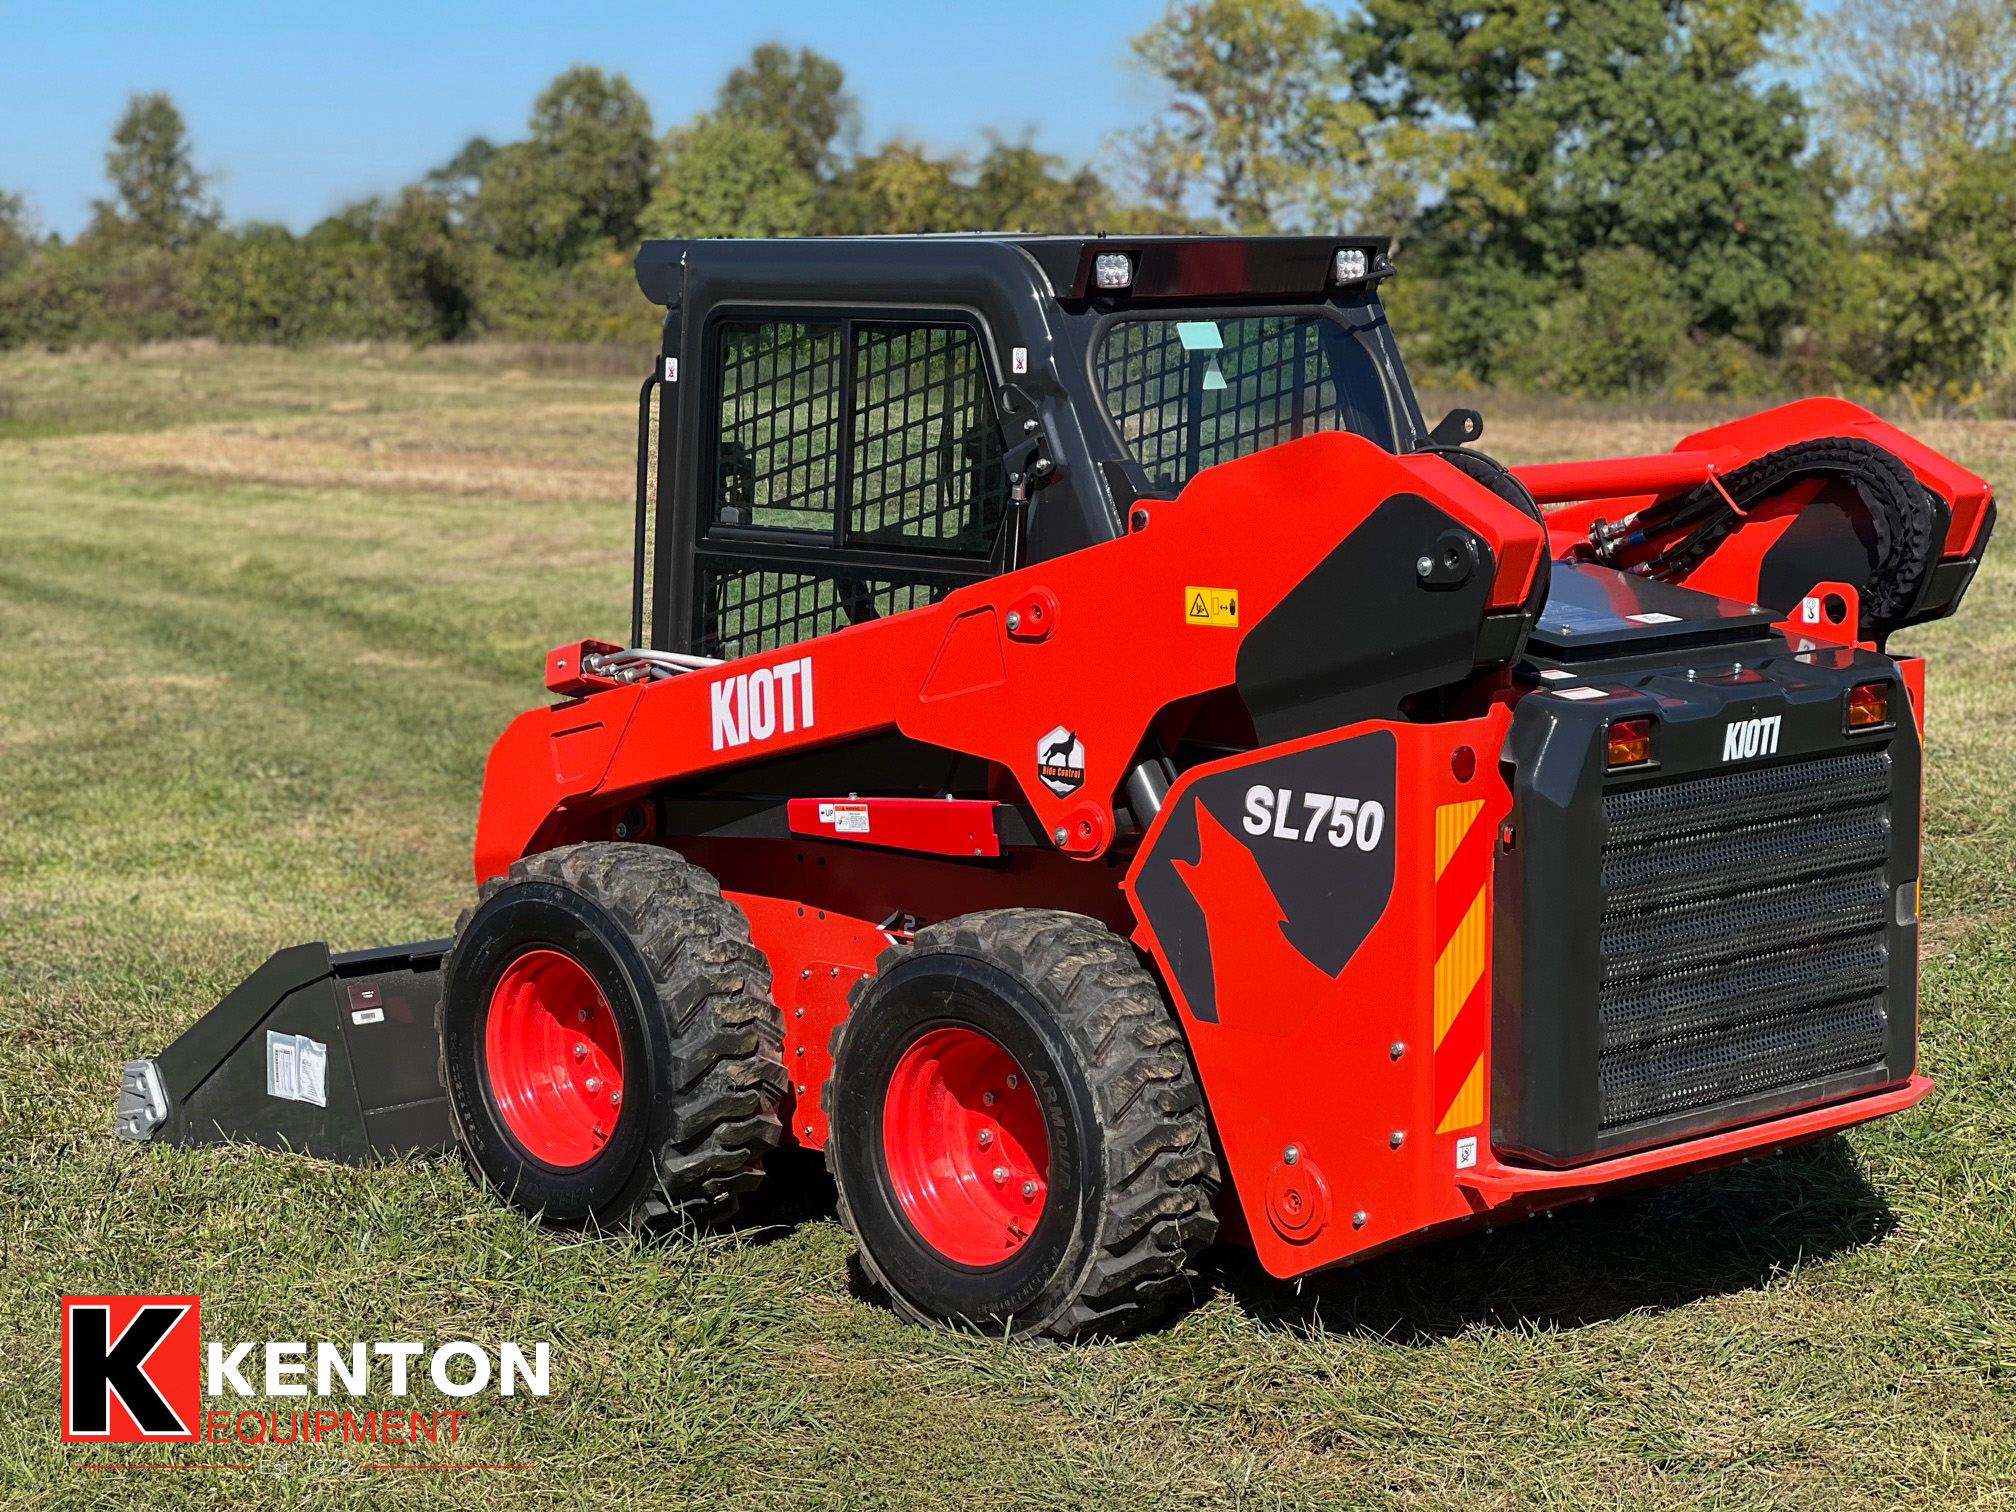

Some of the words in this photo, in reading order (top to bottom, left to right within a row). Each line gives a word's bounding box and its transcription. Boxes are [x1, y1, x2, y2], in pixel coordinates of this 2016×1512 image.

[710, 656, 814, 751] KIOTI
[1722, 715, 1782, 762] KIOTI
[1042, 765, 1057, 776] Ride
[1057, 767, 1081, 779] Control
[825, 809, 834, 818] UP
[1242, 784, 1386, 852] SL750
[1034, 1069, 1072, 1191] ARMOUR
